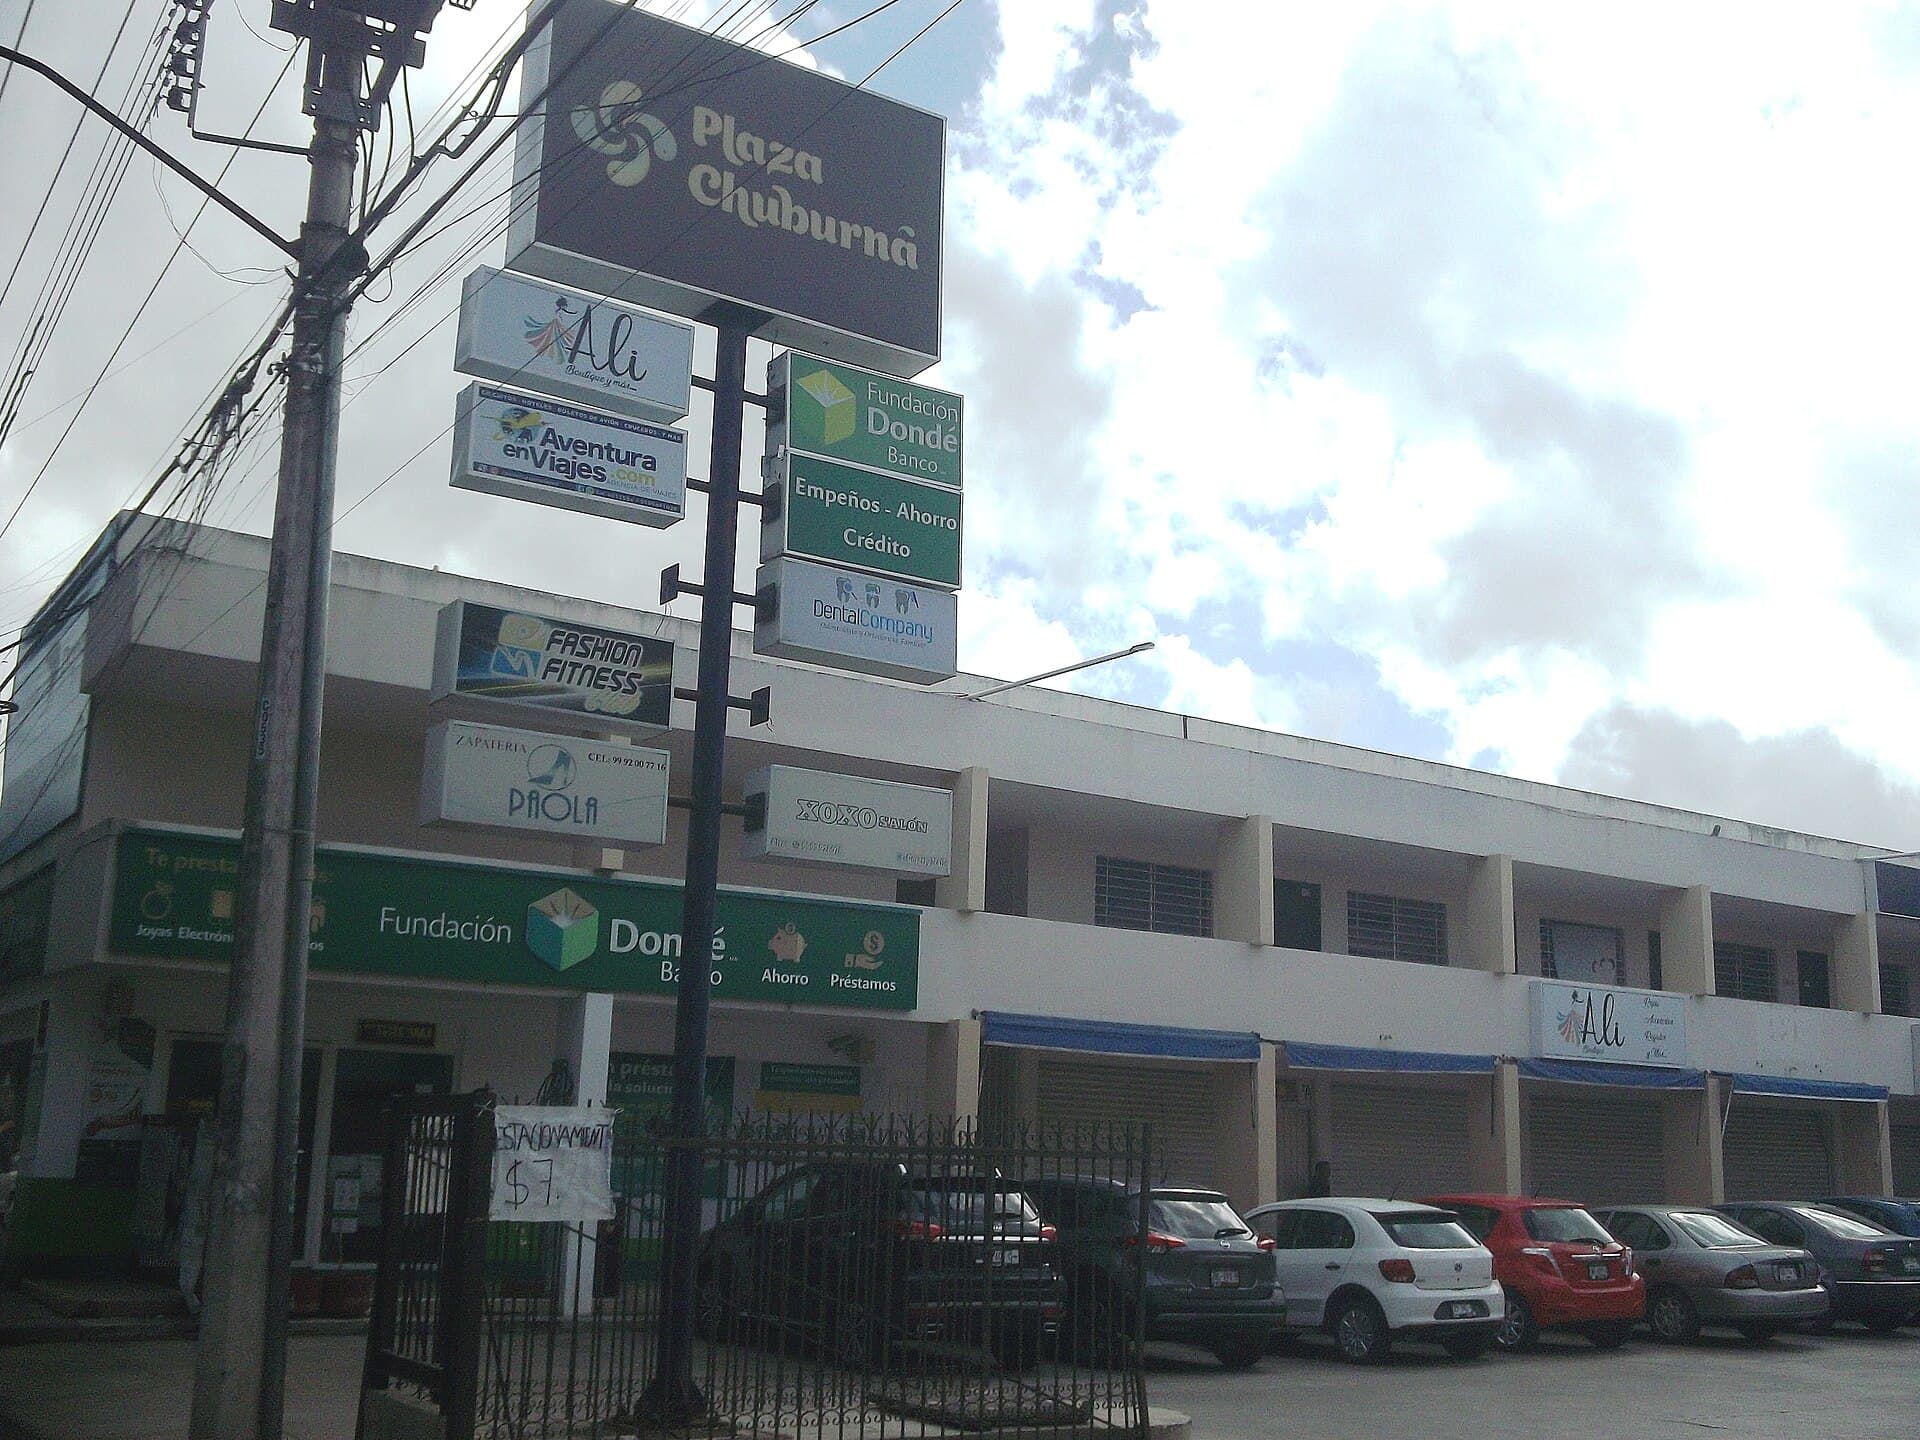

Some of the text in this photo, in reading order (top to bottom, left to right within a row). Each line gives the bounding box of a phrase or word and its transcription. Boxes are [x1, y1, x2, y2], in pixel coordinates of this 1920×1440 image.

[692, 105, 824, 185] Plaza
[565, 304, 648, 382] Ali
[557, 406, 588, 420] BOLETOS
[624, 422, 658, 437] CRUCEROS
[867, 381, 958, 423] Fundación
[540, 427, 657, 472] Aventura
[867, 406, 959, 454] Dondé
[888, 446, 938, 473] Banco
[796, 476, 881, 513] Empeños
[896, 502, 958, 531] Ahorro
[843, 528, 911, 558] Crédito
[544, 627, 643, 669] FASHION
[540, 657, 643, 696] FITNESS
[508, 787, 598, 826] PAOLA
[796, 798, 928, 834] XOXO SALÓN
[146, 846, 239, 875] Te presta
[136, 923, 234, 944] Joyas Electróni
[379, 906, 512, 944] Fundación
[609, 917, 727, 963] Doné
[661, 961, 723, 986] Bao
[762, 968, 809, 986] Ahorro
[830, 973, 897, 992] Préstamos
[1580, 991, 1625, 1047] Ali
